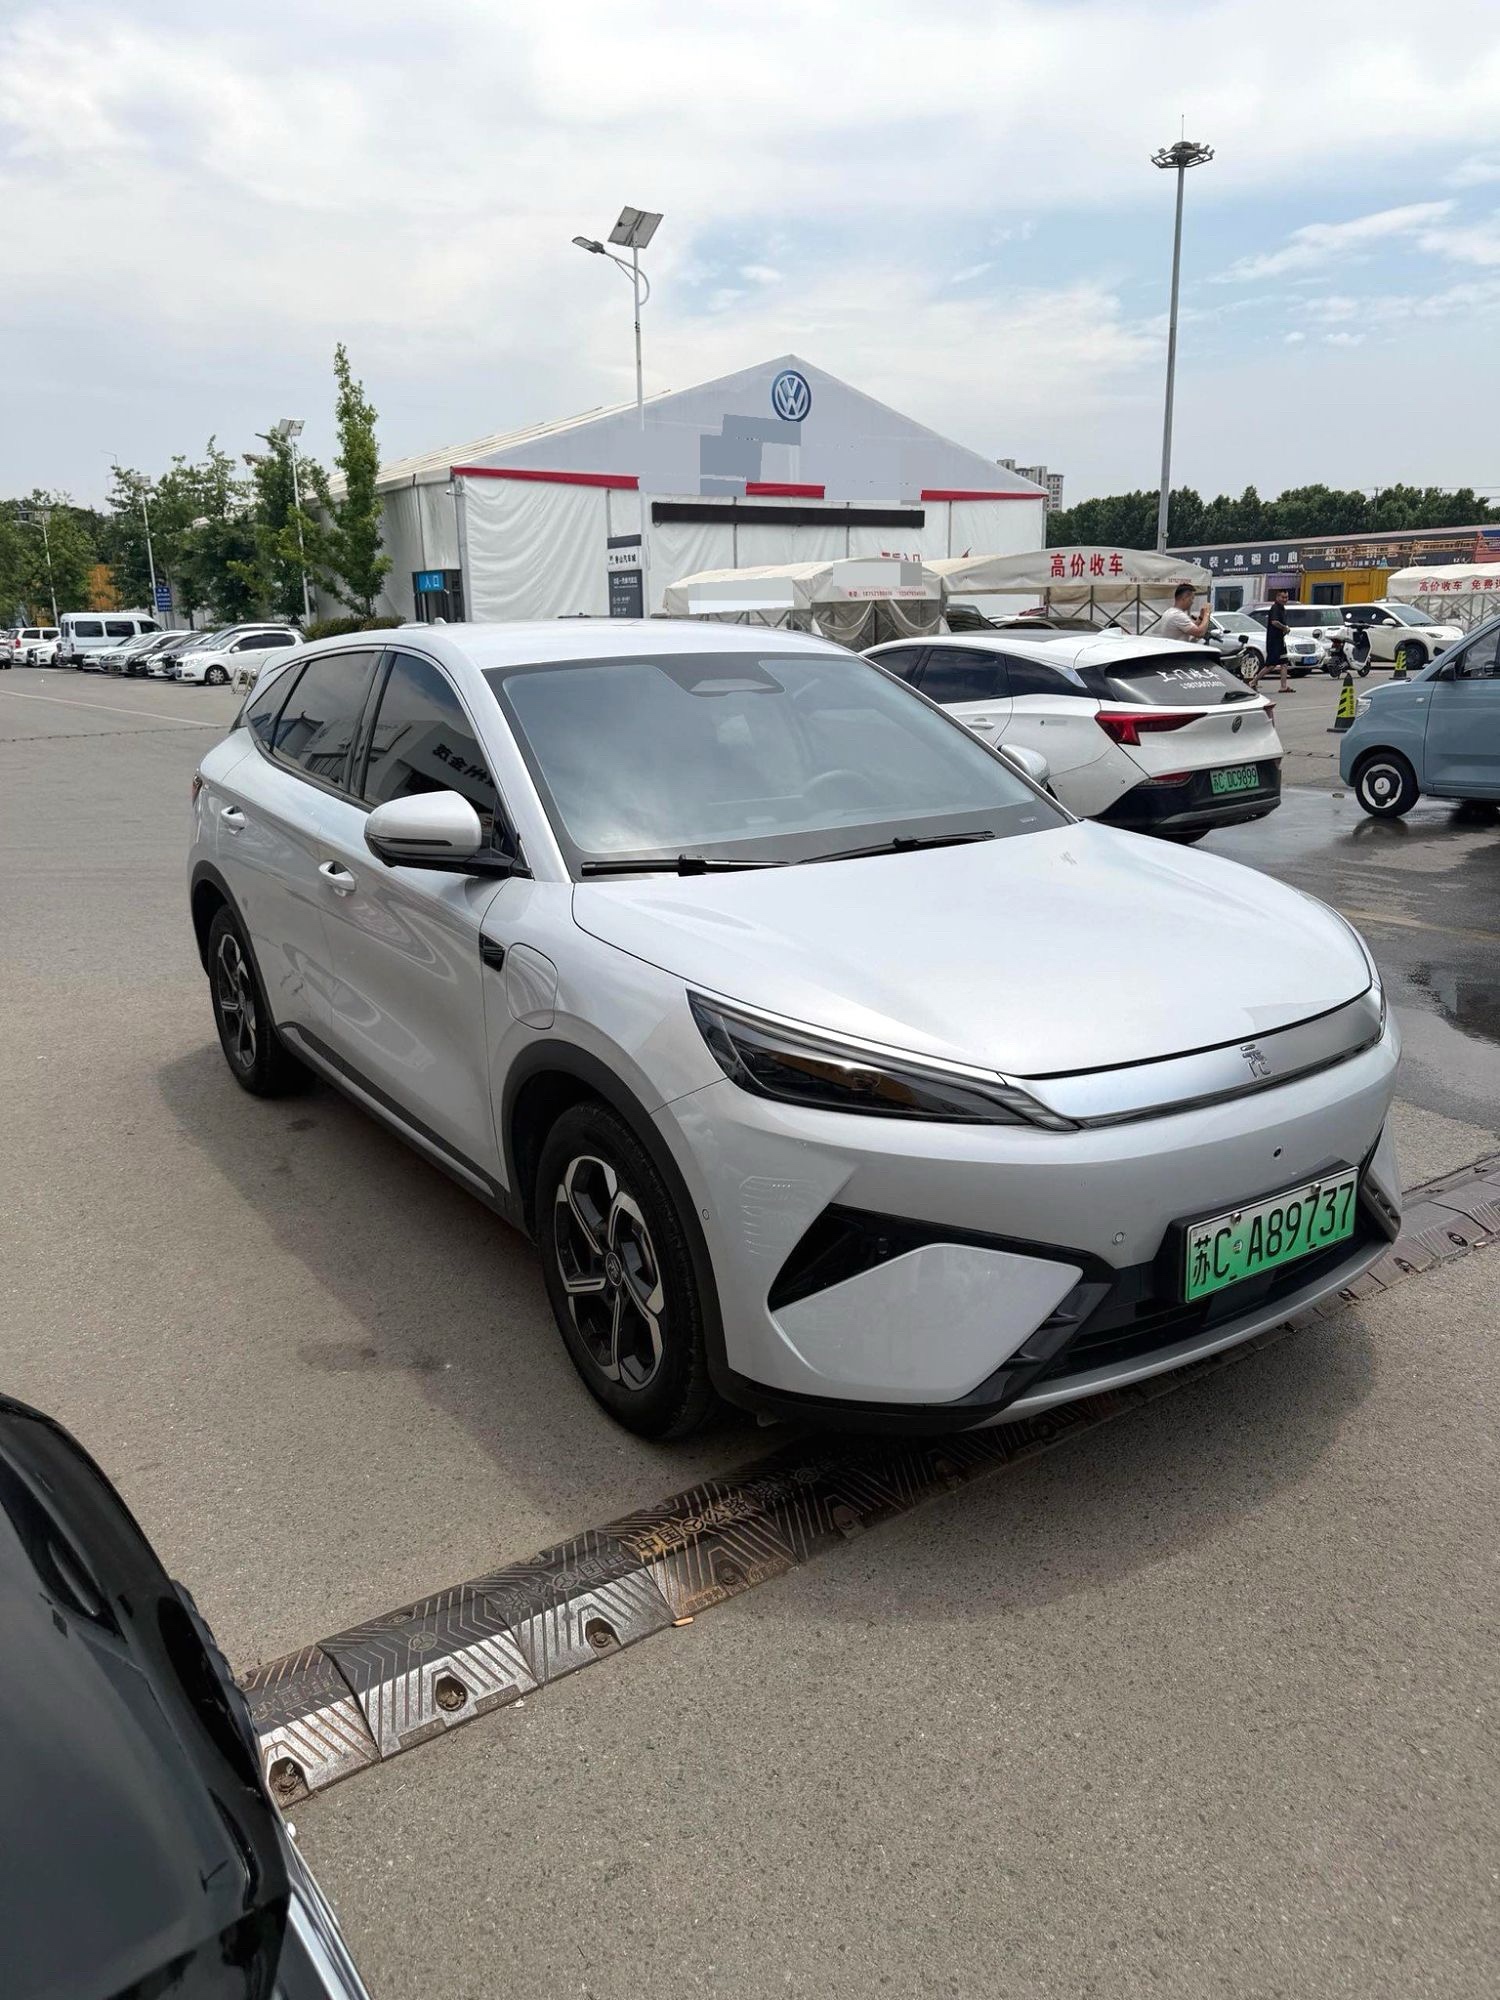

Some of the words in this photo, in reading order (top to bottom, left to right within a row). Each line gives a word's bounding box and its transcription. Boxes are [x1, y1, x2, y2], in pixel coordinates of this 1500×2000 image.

[1050, 553, 1123, 577] 高价收车
[1420, 581, 1462, 592] 高价收车
[1193, 1227, 1232, 1287] 苏C
[1247, 1181, 1354, 1267] A89737
[636, 1525, 681, 1552] 中国
